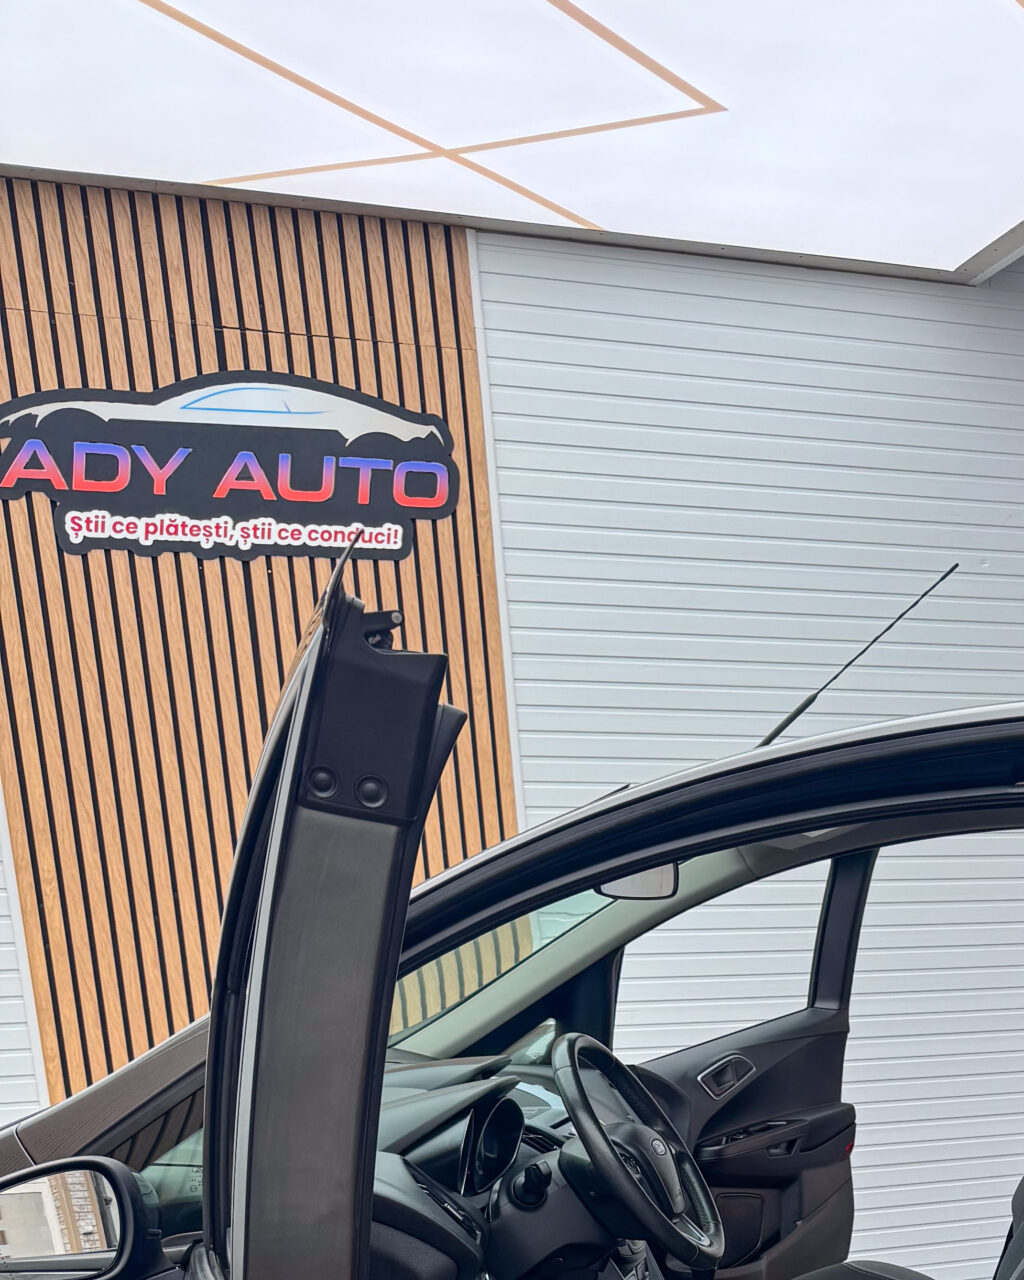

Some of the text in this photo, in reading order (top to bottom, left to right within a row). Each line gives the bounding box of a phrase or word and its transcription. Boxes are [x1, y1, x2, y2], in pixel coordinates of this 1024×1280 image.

[213, 451, 449, 508] AUTO
[70, 514, 399, 545] Știi ce plătești, știi ce conduci!
